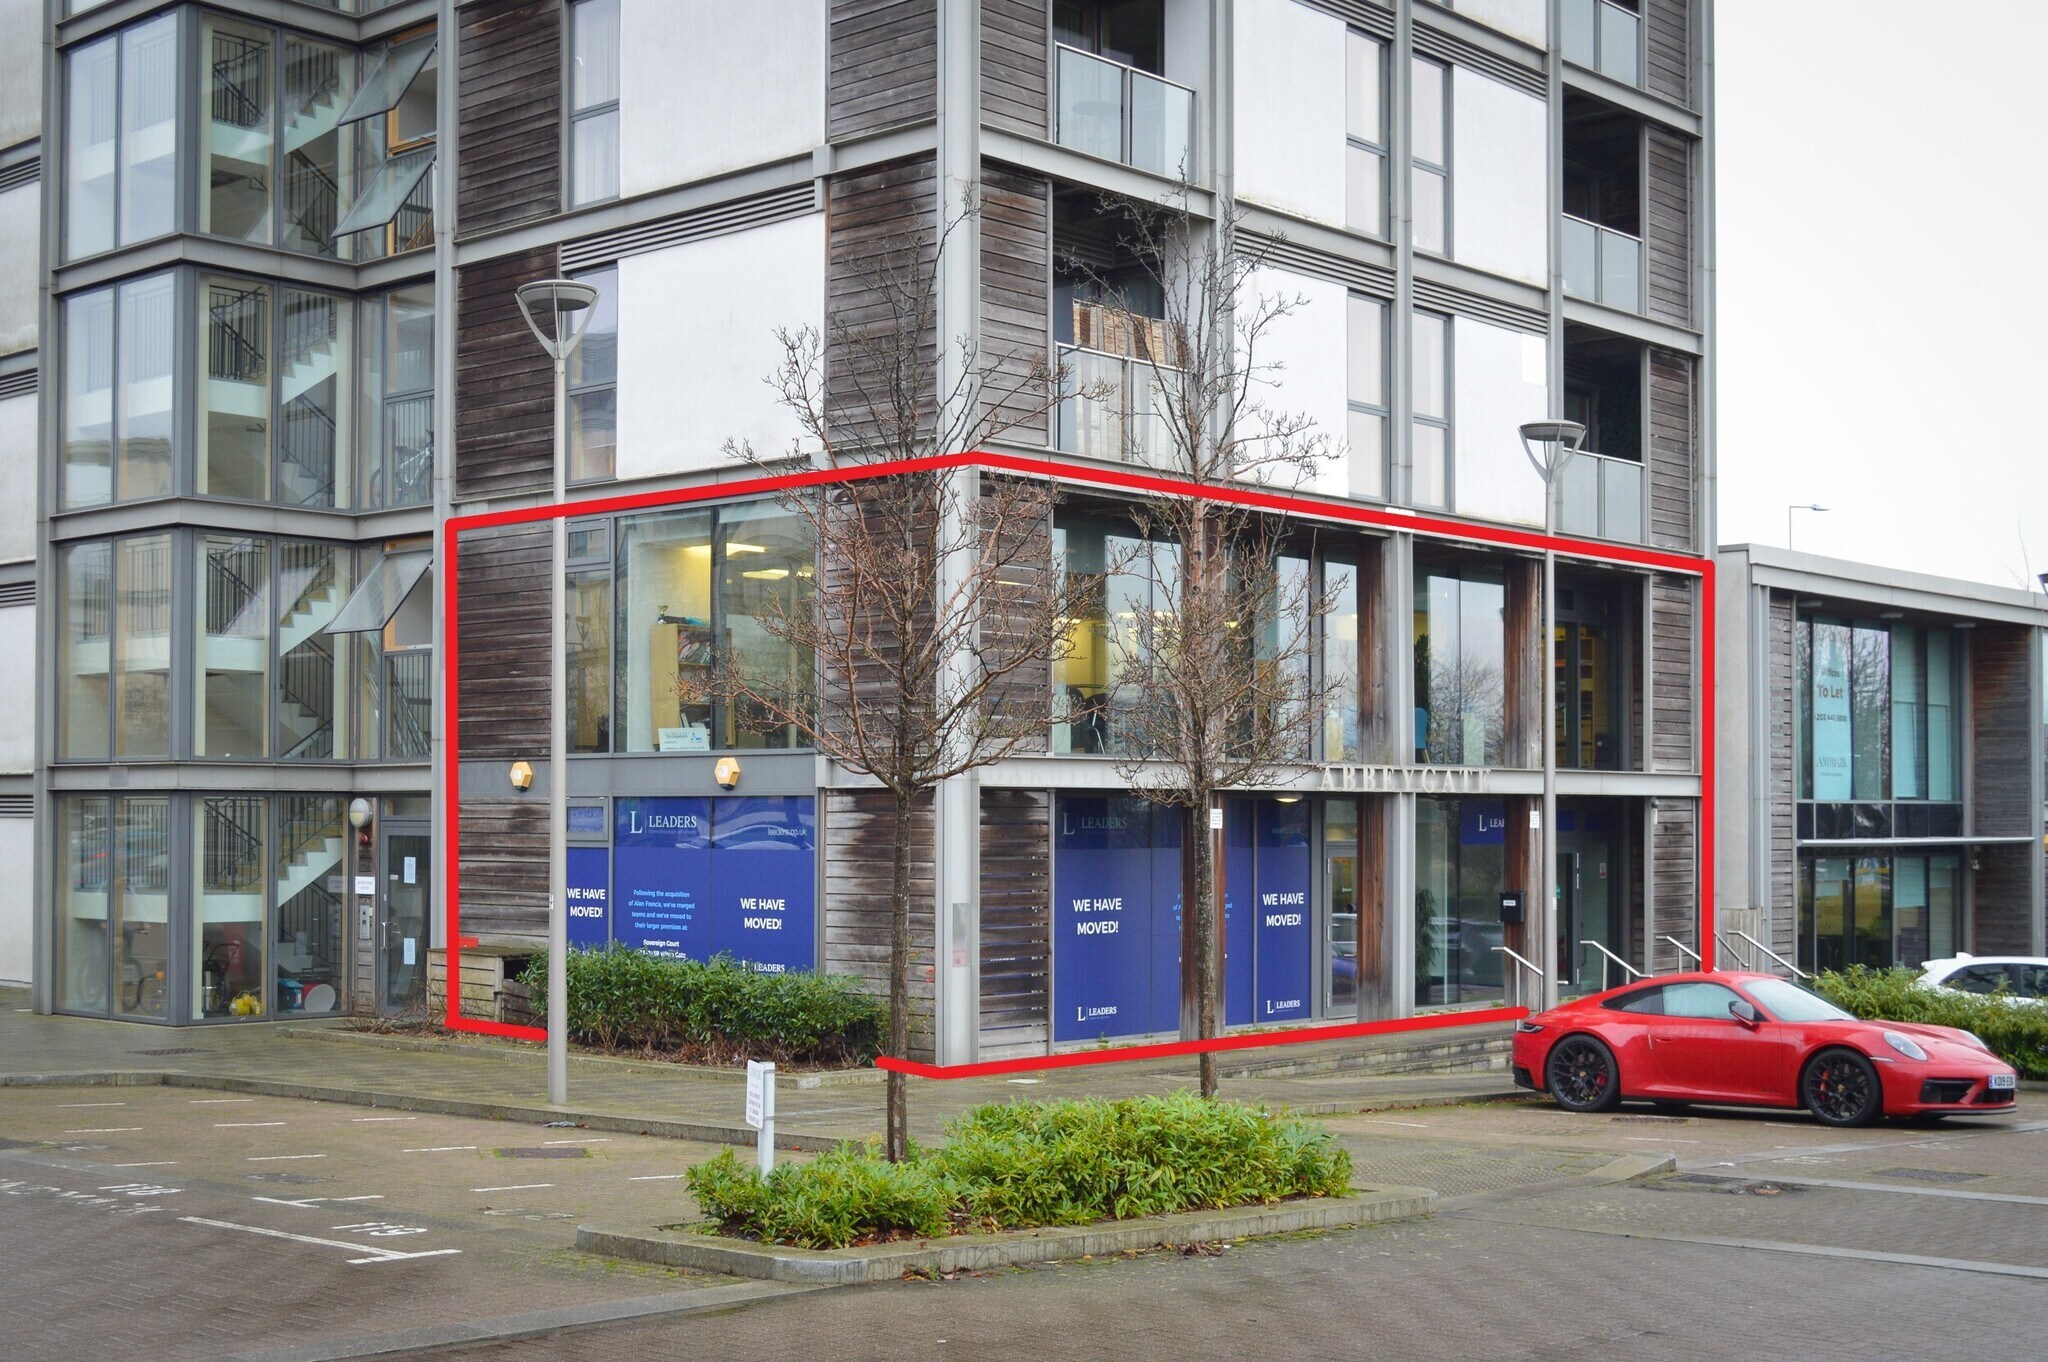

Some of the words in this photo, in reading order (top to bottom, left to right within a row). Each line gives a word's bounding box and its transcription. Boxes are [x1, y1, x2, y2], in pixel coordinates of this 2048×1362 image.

[1816, 684, 1828, 699] To
[1831, 685, 1843, 699] Let
[1815, 756, 1848, 768] ANDMARK
[1320, 766, 1491, 793] ABBEYGATE
[630, 811, 643, 834] L
[648, 815, 697, 828] LEADERS
[1062, 812, 1076, 836] L
[1081, 816, 1127, 829] LEADERS
[1479, 814, 1487, 832] L
[767, 827, 808, 837] leaders.co.uk
[566, 887, 581, 899] WE
[582, 888, 606, 900] HAVE
[1262, 893, 1279, 906] WE
[1280, 892, 1305, 905] HAVE
[740, 898, 757, 909] WE
[758, 898, 786, 911] HAVE
[1072, 899, 1092, 912] WE
[1093, 897, 1122, 911] HAVE
[569, 906, 604, 918] MOVED!
[744, 917, 783, 930] MOVED!
[1266, 914, 1302, 927] MOVED!
[1077, 921, 1119, 935] MOVED!
[643, 939, 665, 947] Sovereign
[753, 963, 786, 973] LEADERS
[1077, 1006, 1086, 1021] L
[1088, 1006, 1118, 1016] LEADERS
[1266, 1000, 1275, 1014] L
[1276, 1000, 1301, 1009] LEADERS
